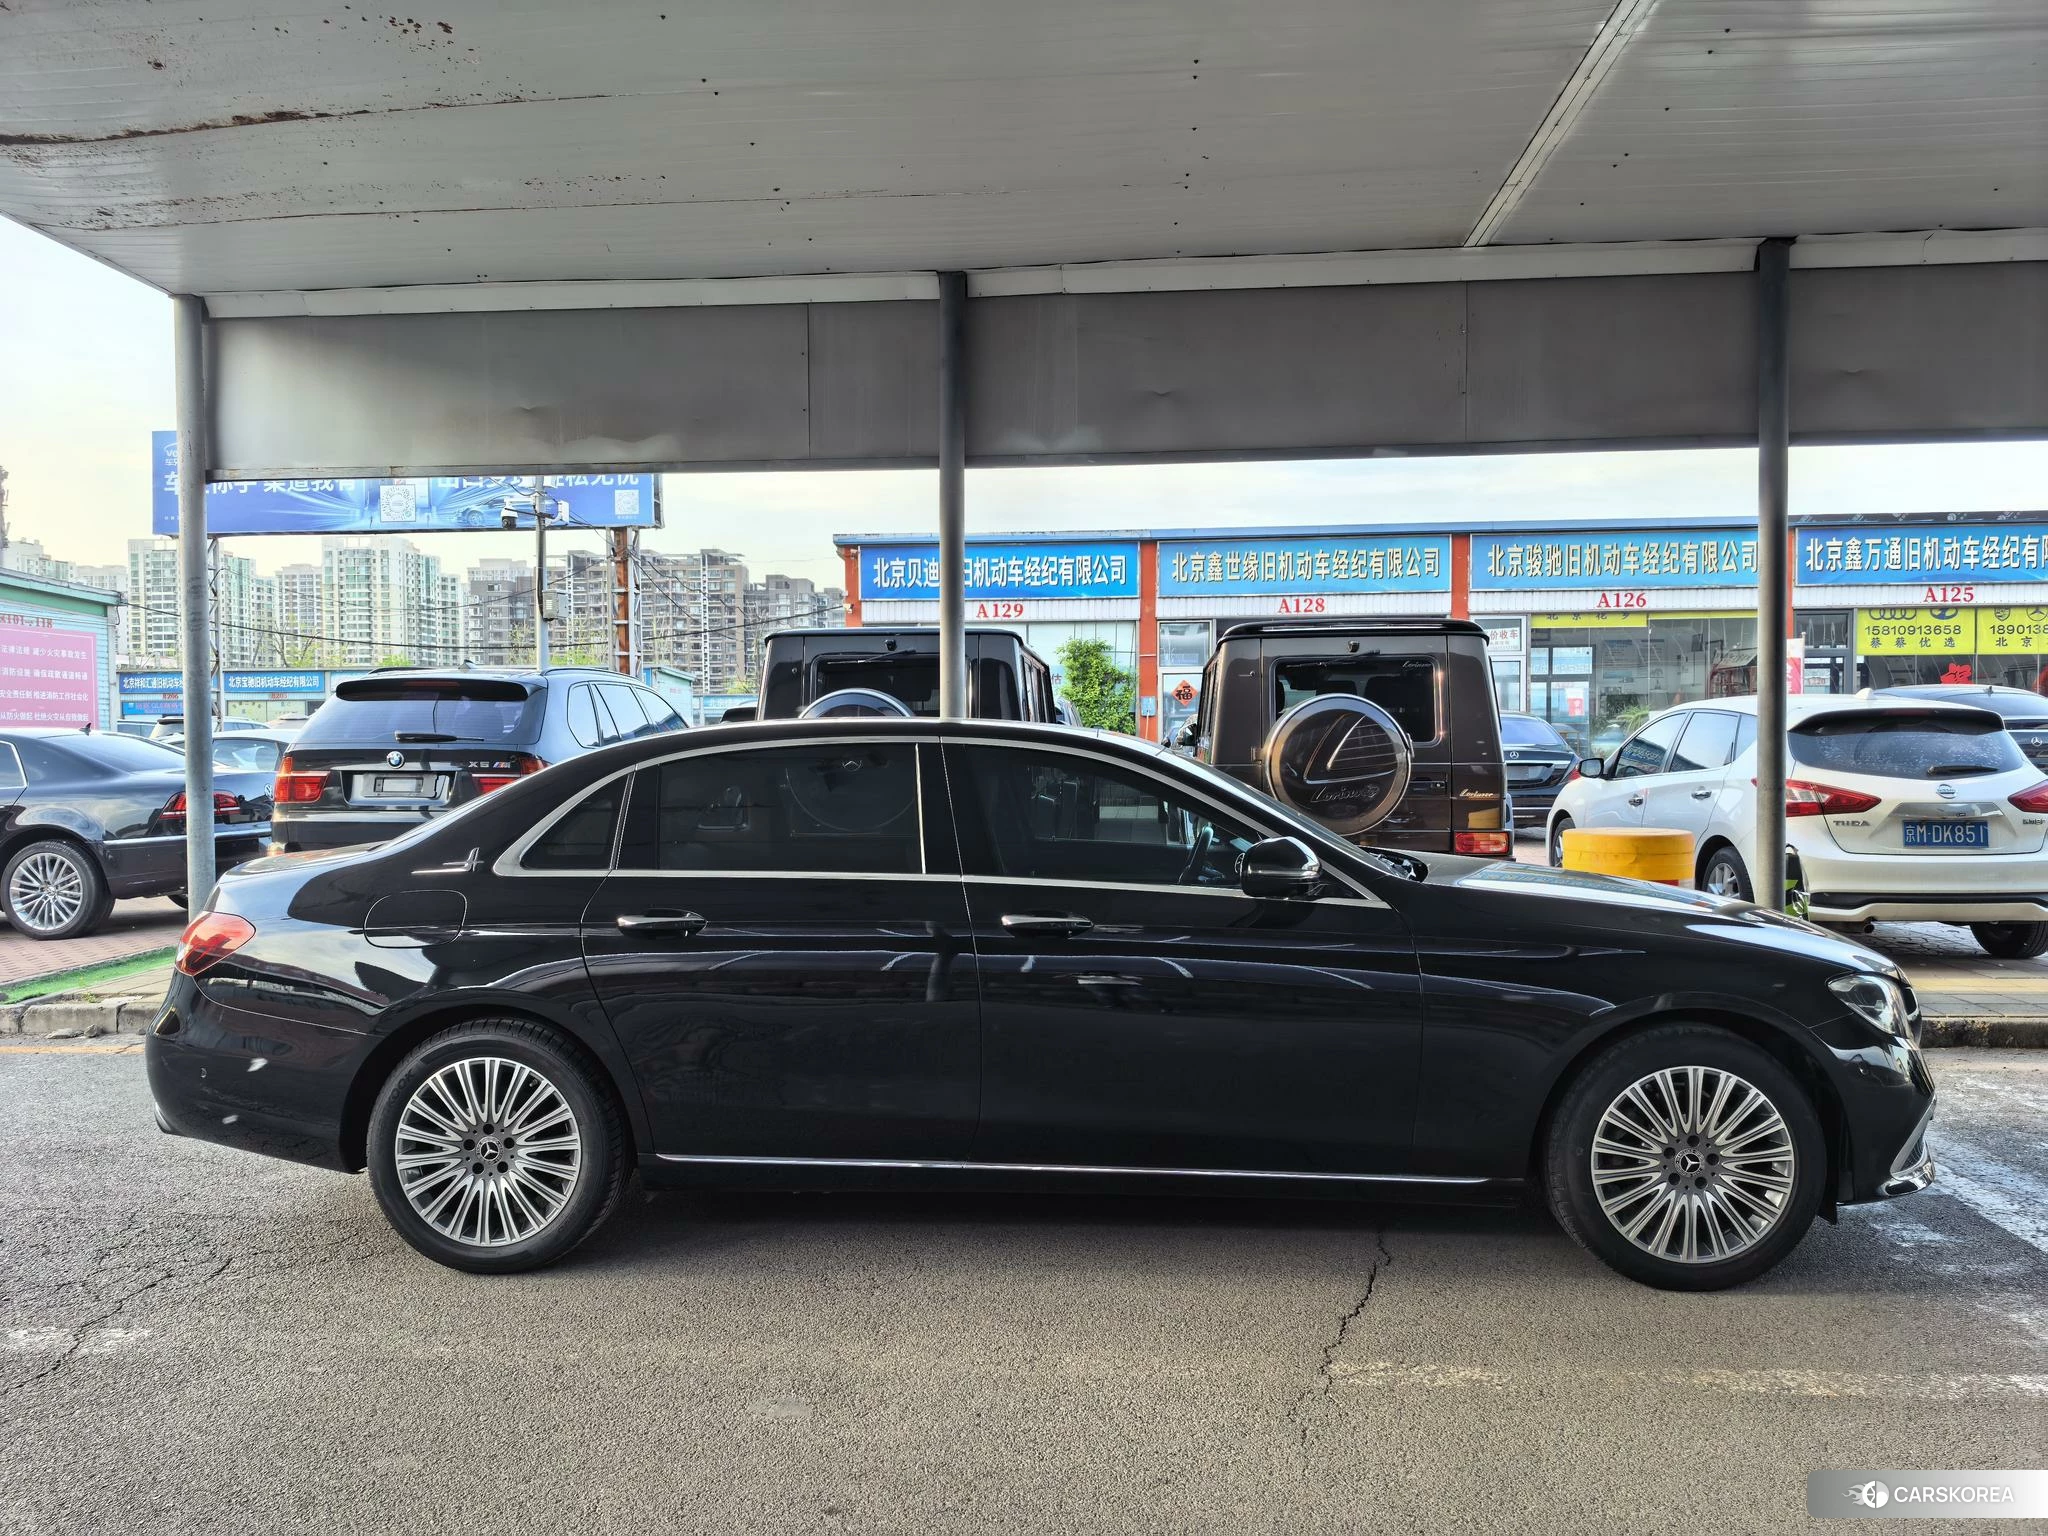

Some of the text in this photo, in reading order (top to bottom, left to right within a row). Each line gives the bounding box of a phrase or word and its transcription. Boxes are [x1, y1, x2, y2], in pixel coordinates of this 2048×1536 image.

[1172, 547, 1440, 582] 北京鑫世缘旧机动车经纪有限公司
[1487, 540, 1758, 577] 北京骏驰旧机动车经纪有限公司
[873, 555, 1126, 588] 北京贝迪旧机动车经纪有限公司
[1596, 593, 1647, 608] A126
[1924, 587, 1974, 602] A125
[976, 604, 1024, 618] A129
[1278, 598, 1325, 613] A128
[1865, 625, 1961, 635] 15810913658
[123, 677, 183, 689] 北京祥和汇通旧机动车
[1175, 685, 1193, 700] 福
